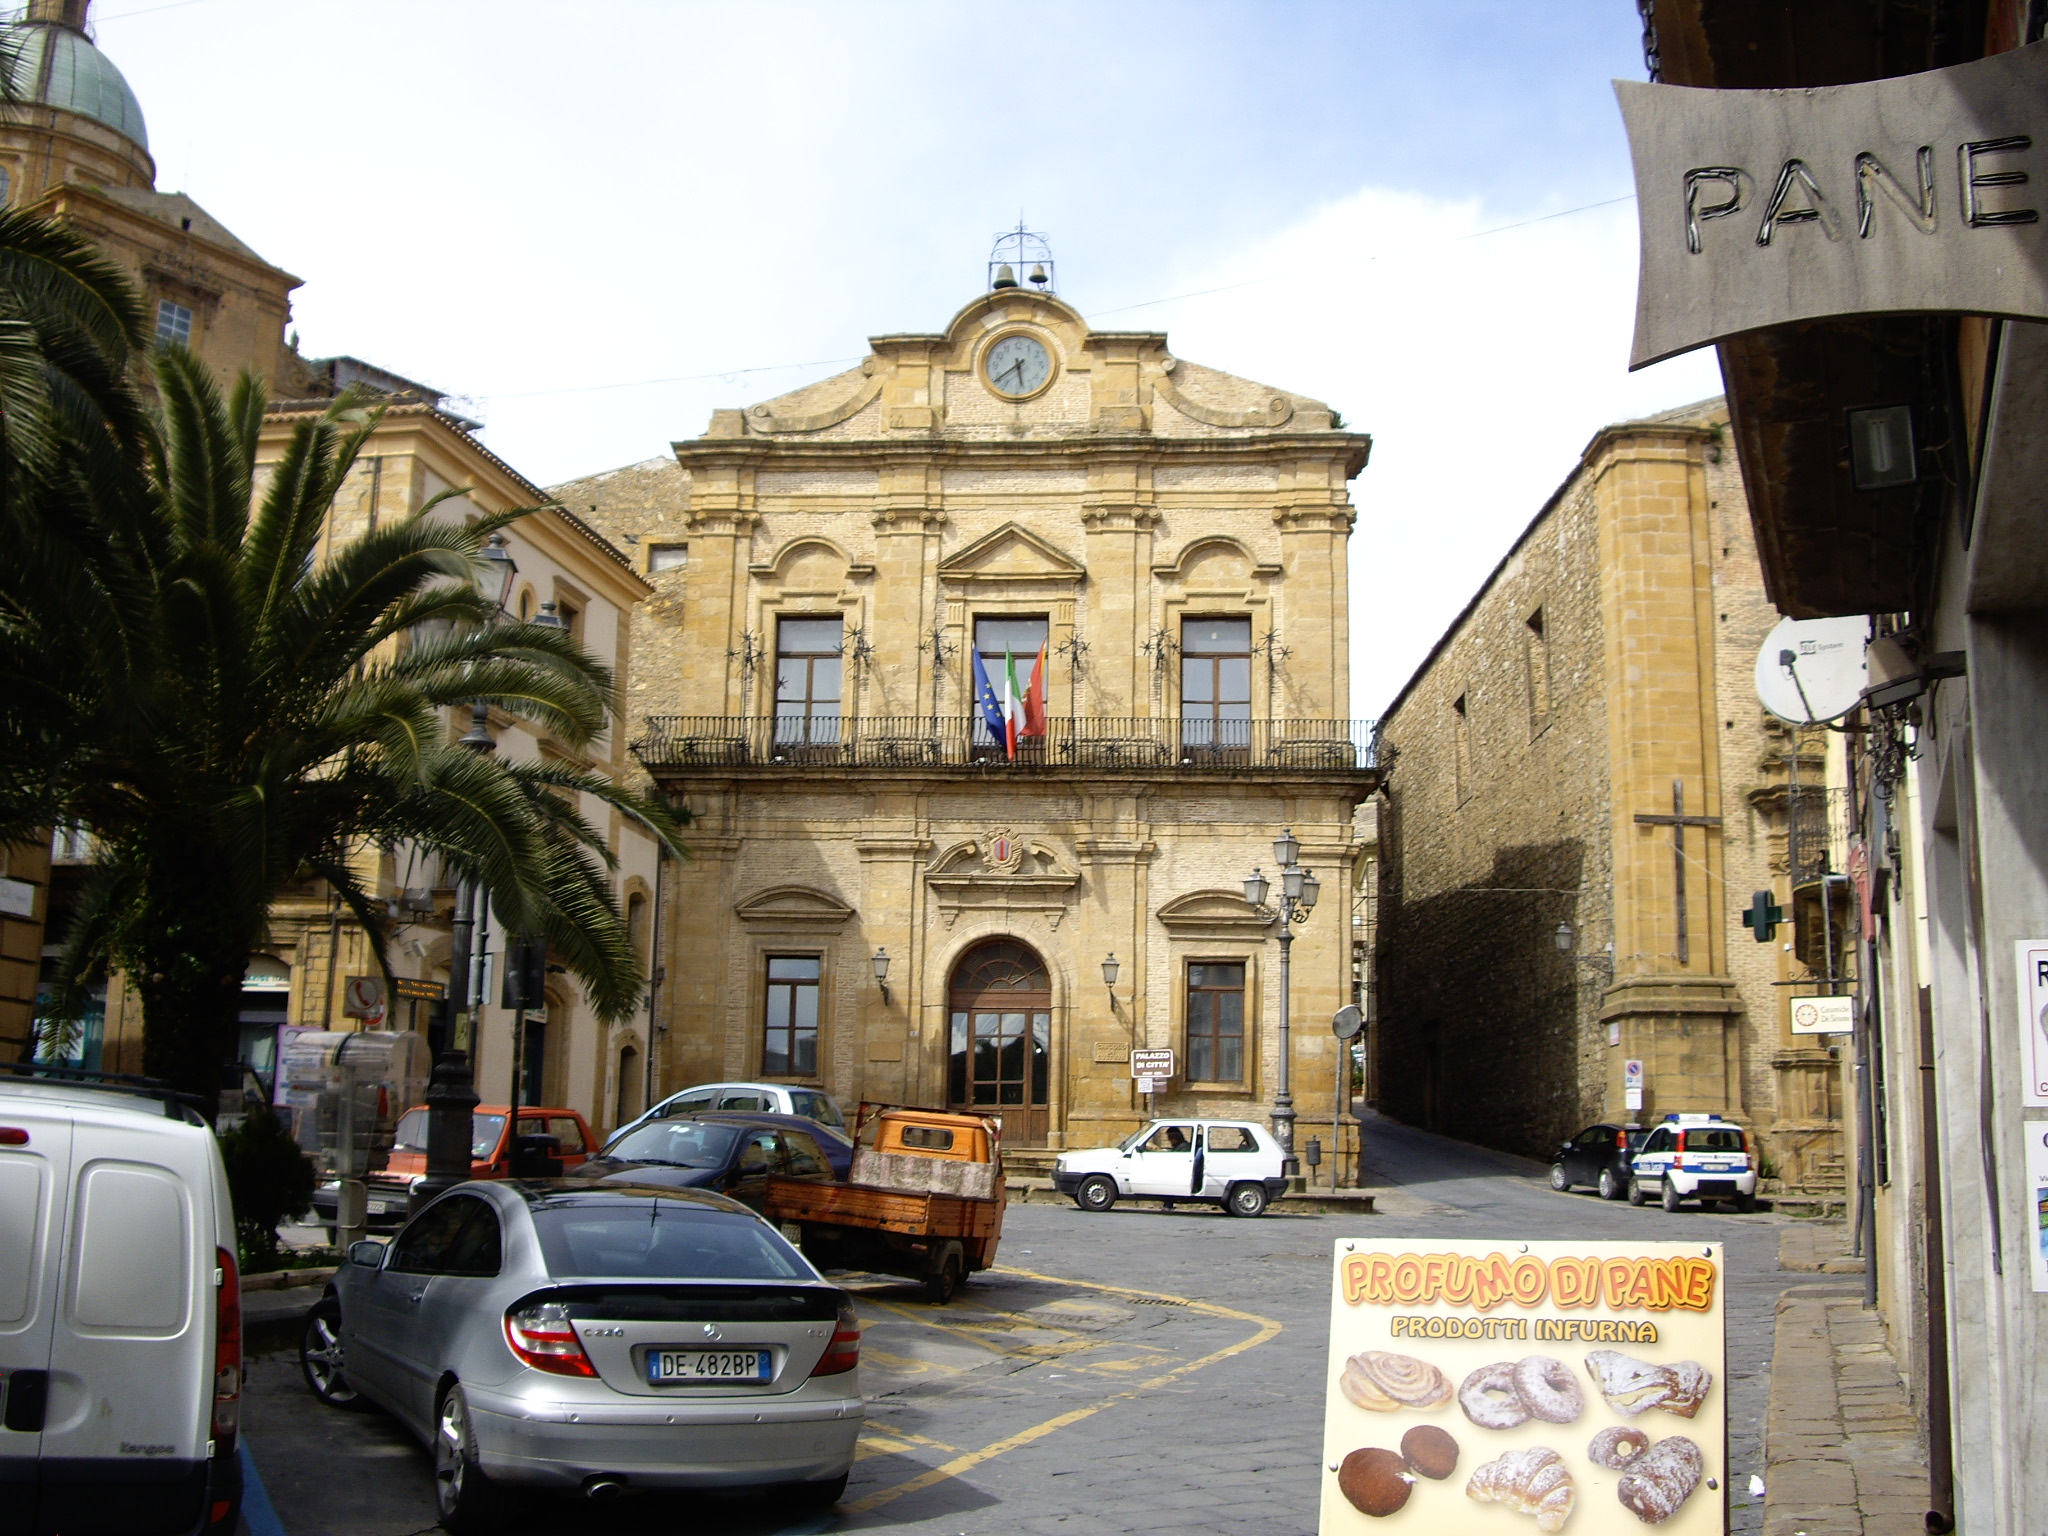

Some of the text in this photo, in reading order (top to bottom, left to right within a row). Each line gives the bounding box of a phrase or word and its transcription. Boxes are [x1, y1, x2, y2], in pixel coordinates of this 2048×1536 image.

[1683, 134, 2040, 255] PANE
[1818, 642, 1844, 652] System
[1341, 1252, 1716, 1313] PROFUMO DI PANE
[583, 1327, 624, 1338] C 220
[1390, 1315, 1659, 1343] PRODOTTI INFURNA
[663, 1354, 757, 1377] DE 482BP
